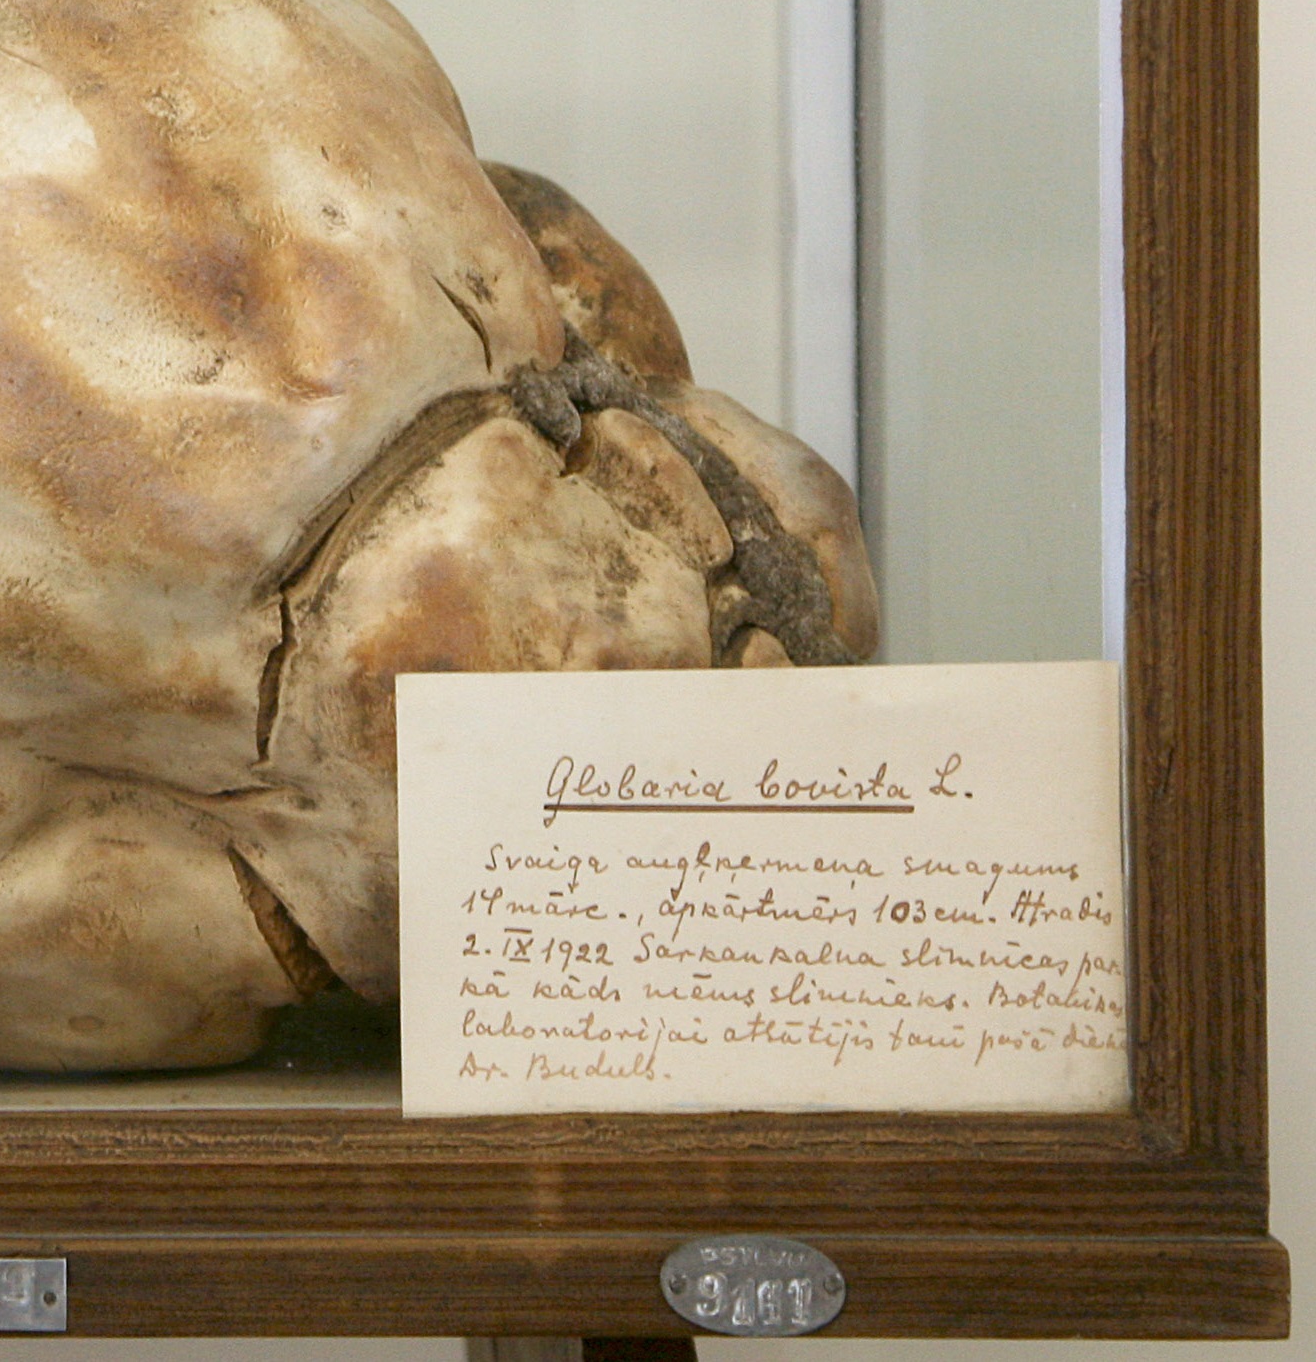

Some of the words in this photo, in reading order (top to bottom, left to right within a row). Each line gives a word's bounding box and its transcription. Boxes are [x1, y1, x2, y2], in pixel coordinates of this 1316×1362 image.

[543, 755, 732, 828] Globaria
[755, 758, 912, 800] bovista
[928, 753, 974, 798] L.
[541, 937, 614, 972] 1922
